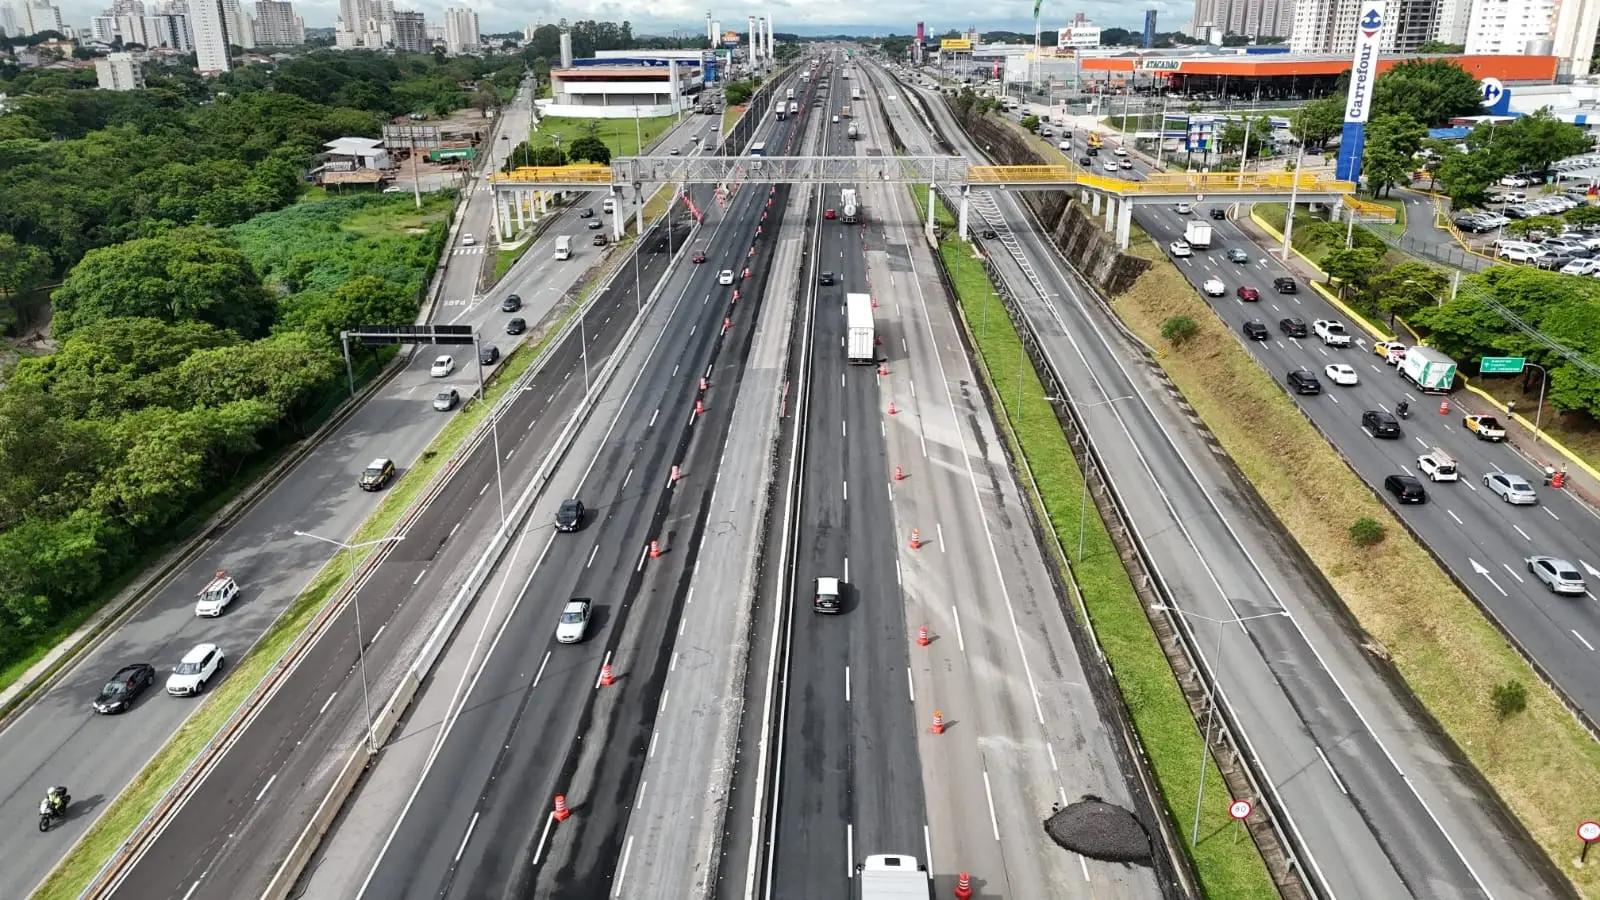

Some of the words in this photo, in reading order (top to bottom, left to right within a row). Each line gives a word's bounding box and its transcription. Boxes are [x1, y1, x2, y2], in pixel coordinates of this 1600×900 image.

[1145, 60, 1180, 69] ATACADÃO
[1350, 43, 1372, 118] Carrefour
[1235, 805, 1247, 813] 80
